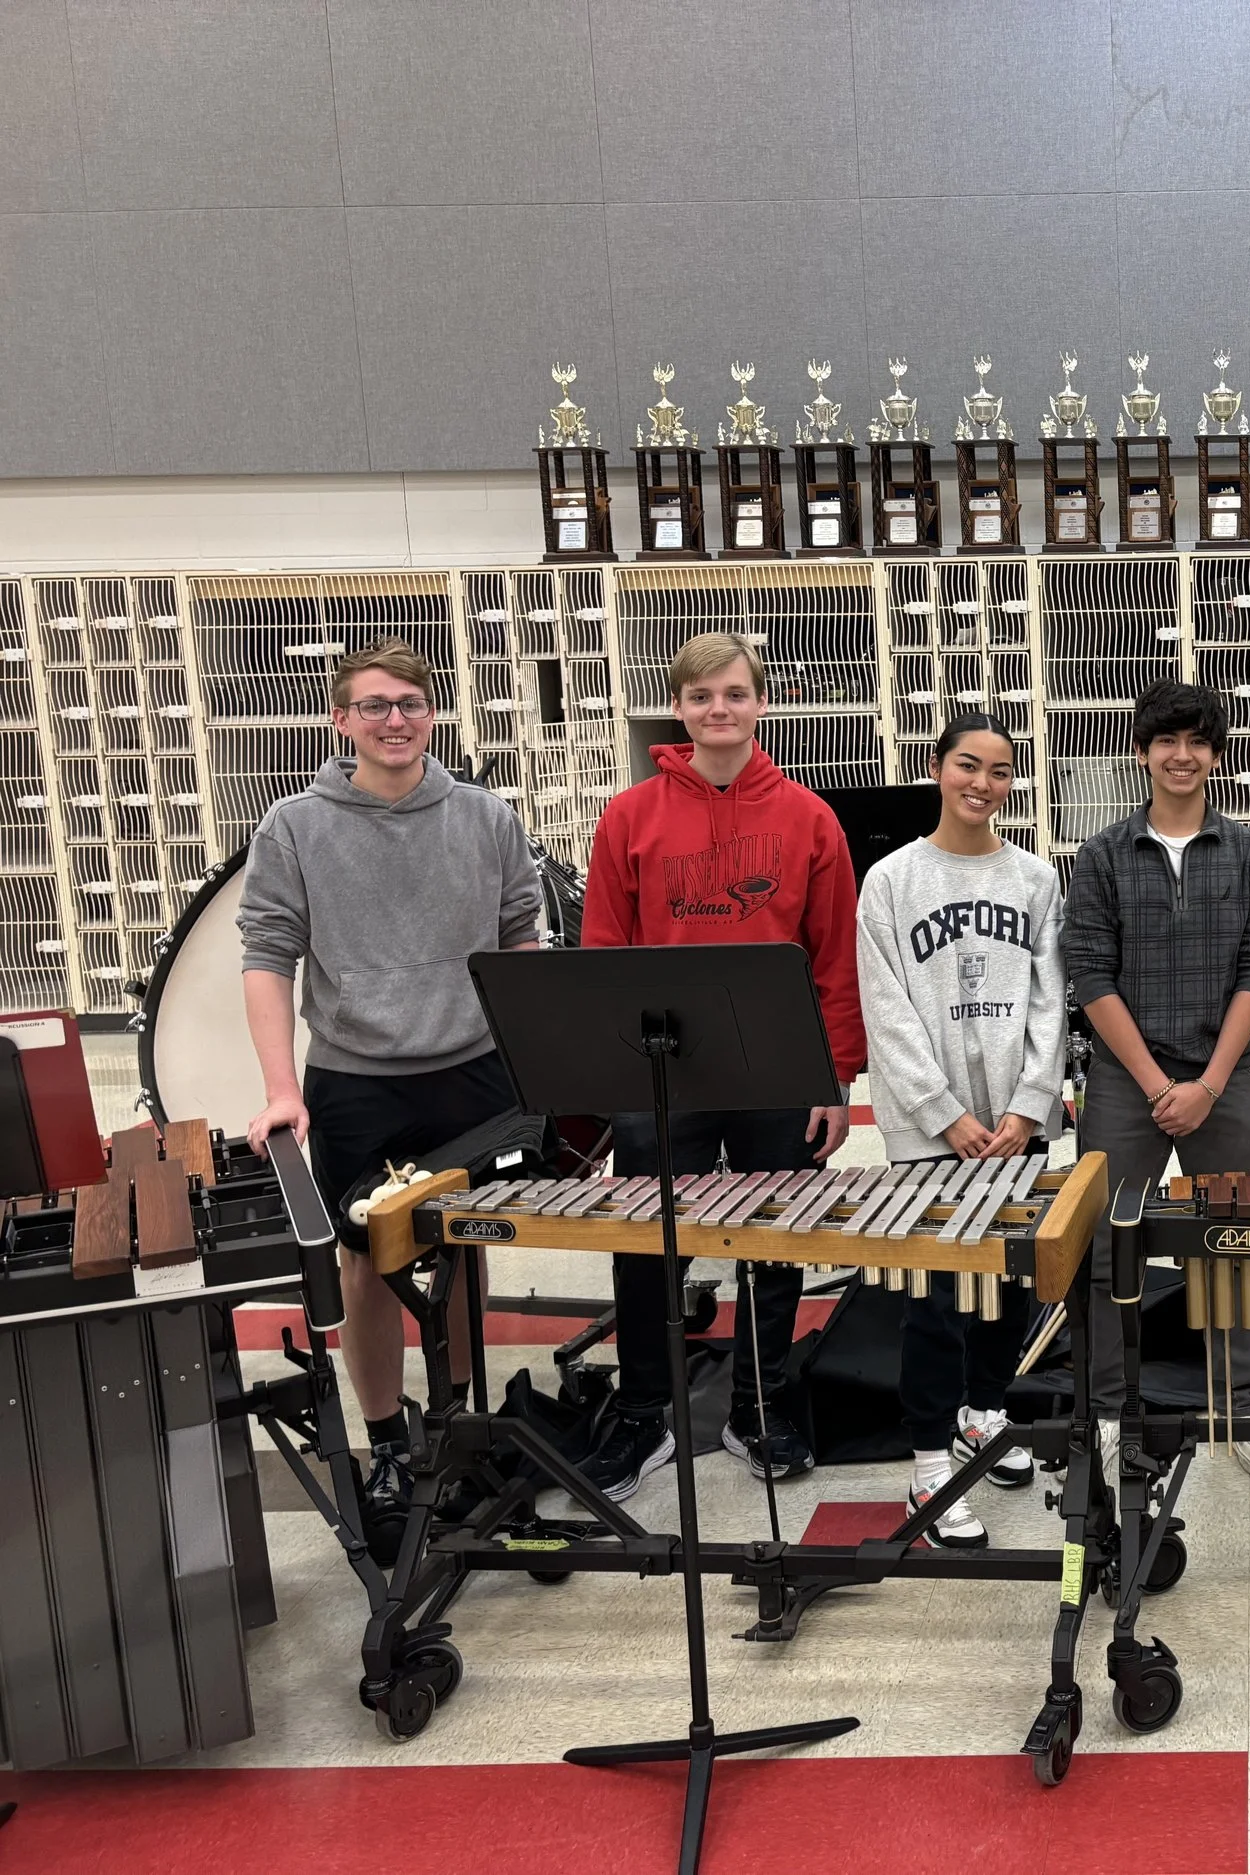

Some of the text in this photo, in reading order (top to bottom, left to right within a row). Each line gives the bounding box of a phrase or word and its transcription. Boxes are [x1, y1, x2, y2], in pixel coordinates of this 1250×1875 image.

[670, 898, 732, 920] Cyclones
[950, 1002, 1014, 1020] UVERSITY
[463, 1221, 501, 1237] ADAMS
[1063, 1579, 1081, 1601] RHS
